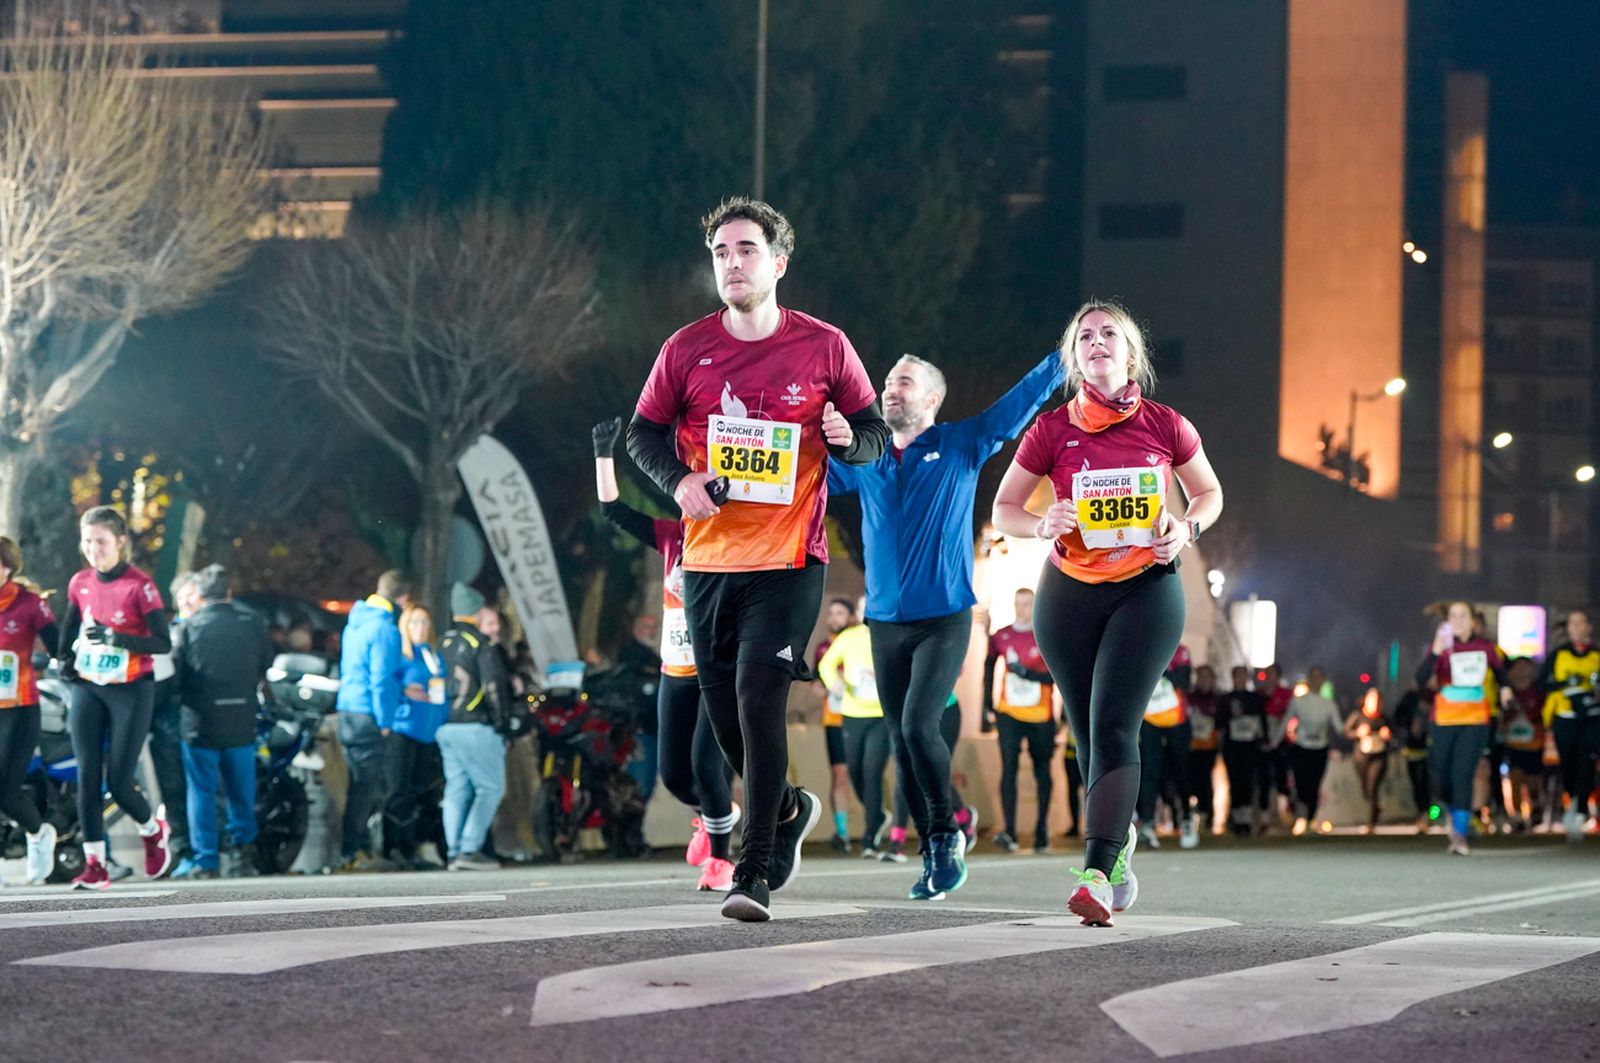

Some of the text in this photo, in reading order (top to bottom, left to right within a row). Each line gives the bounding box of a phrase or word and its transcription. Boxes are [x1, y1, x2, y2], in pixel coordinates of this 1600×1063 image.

[726, 426, 752, 436] NOCHE
[753, 428, 765, 437] DE
[715, 435, 733, 444] SAN
[734, 435, 764, 447] ANTÓN
[720, 446, 780, 475] 3364
[1092, 479, 1120, 487] NOCHE
[1120, 478, 1131, 486] DE
[1083, 489, 1100, 498] SAN
[1102, 485, 1132, 497] ANTÓN
[1089, 496, 1149, 522] 3365
[500, 470, 564, 618] JAPEMASA
